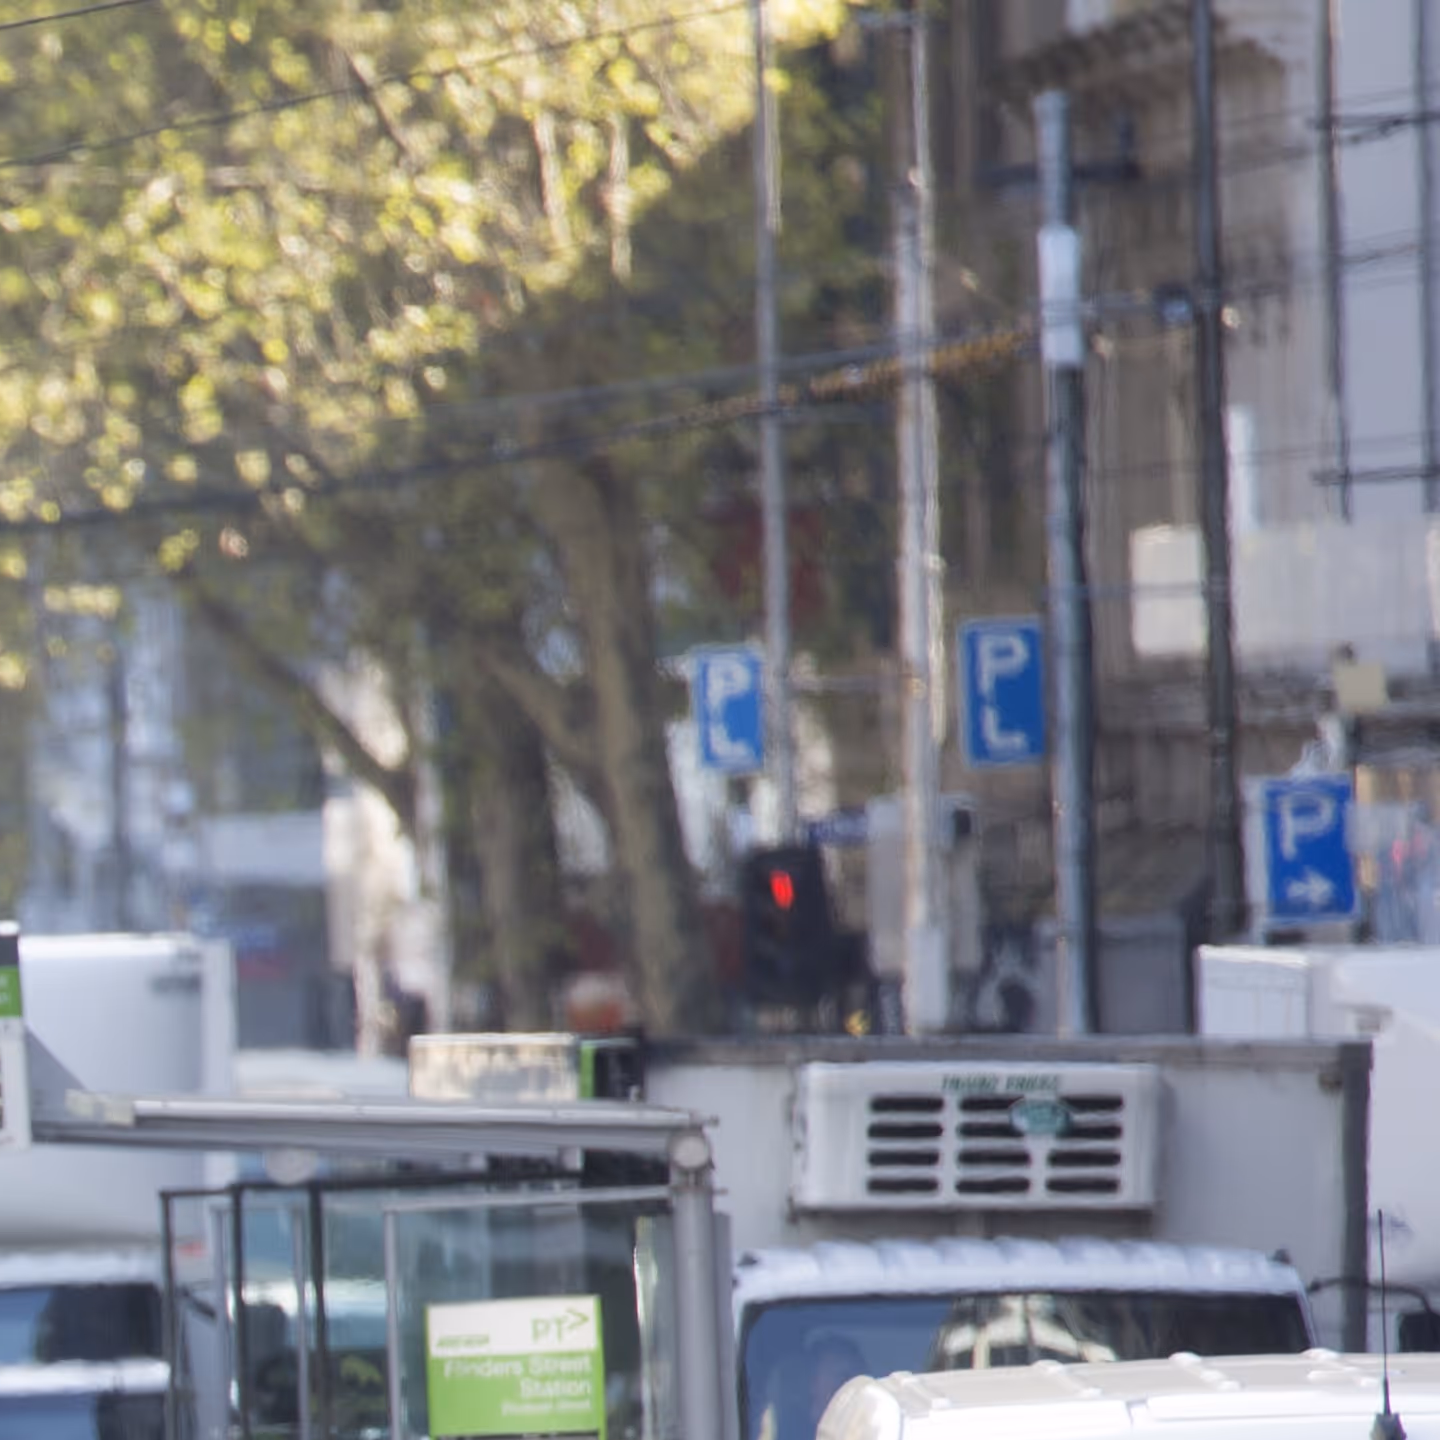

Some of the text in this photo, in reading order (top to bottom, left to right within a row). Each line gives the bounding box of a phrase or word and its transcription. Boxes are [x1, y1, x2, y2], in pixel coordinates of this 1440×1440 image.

[707, 657, 752, 706] P
[977, 633, 1029, 693] P
[1278, 794, 1335, 862] P
[444, 1354, 592, 1379] Flinders Street
[520, 1376, 592, 1398] Station
